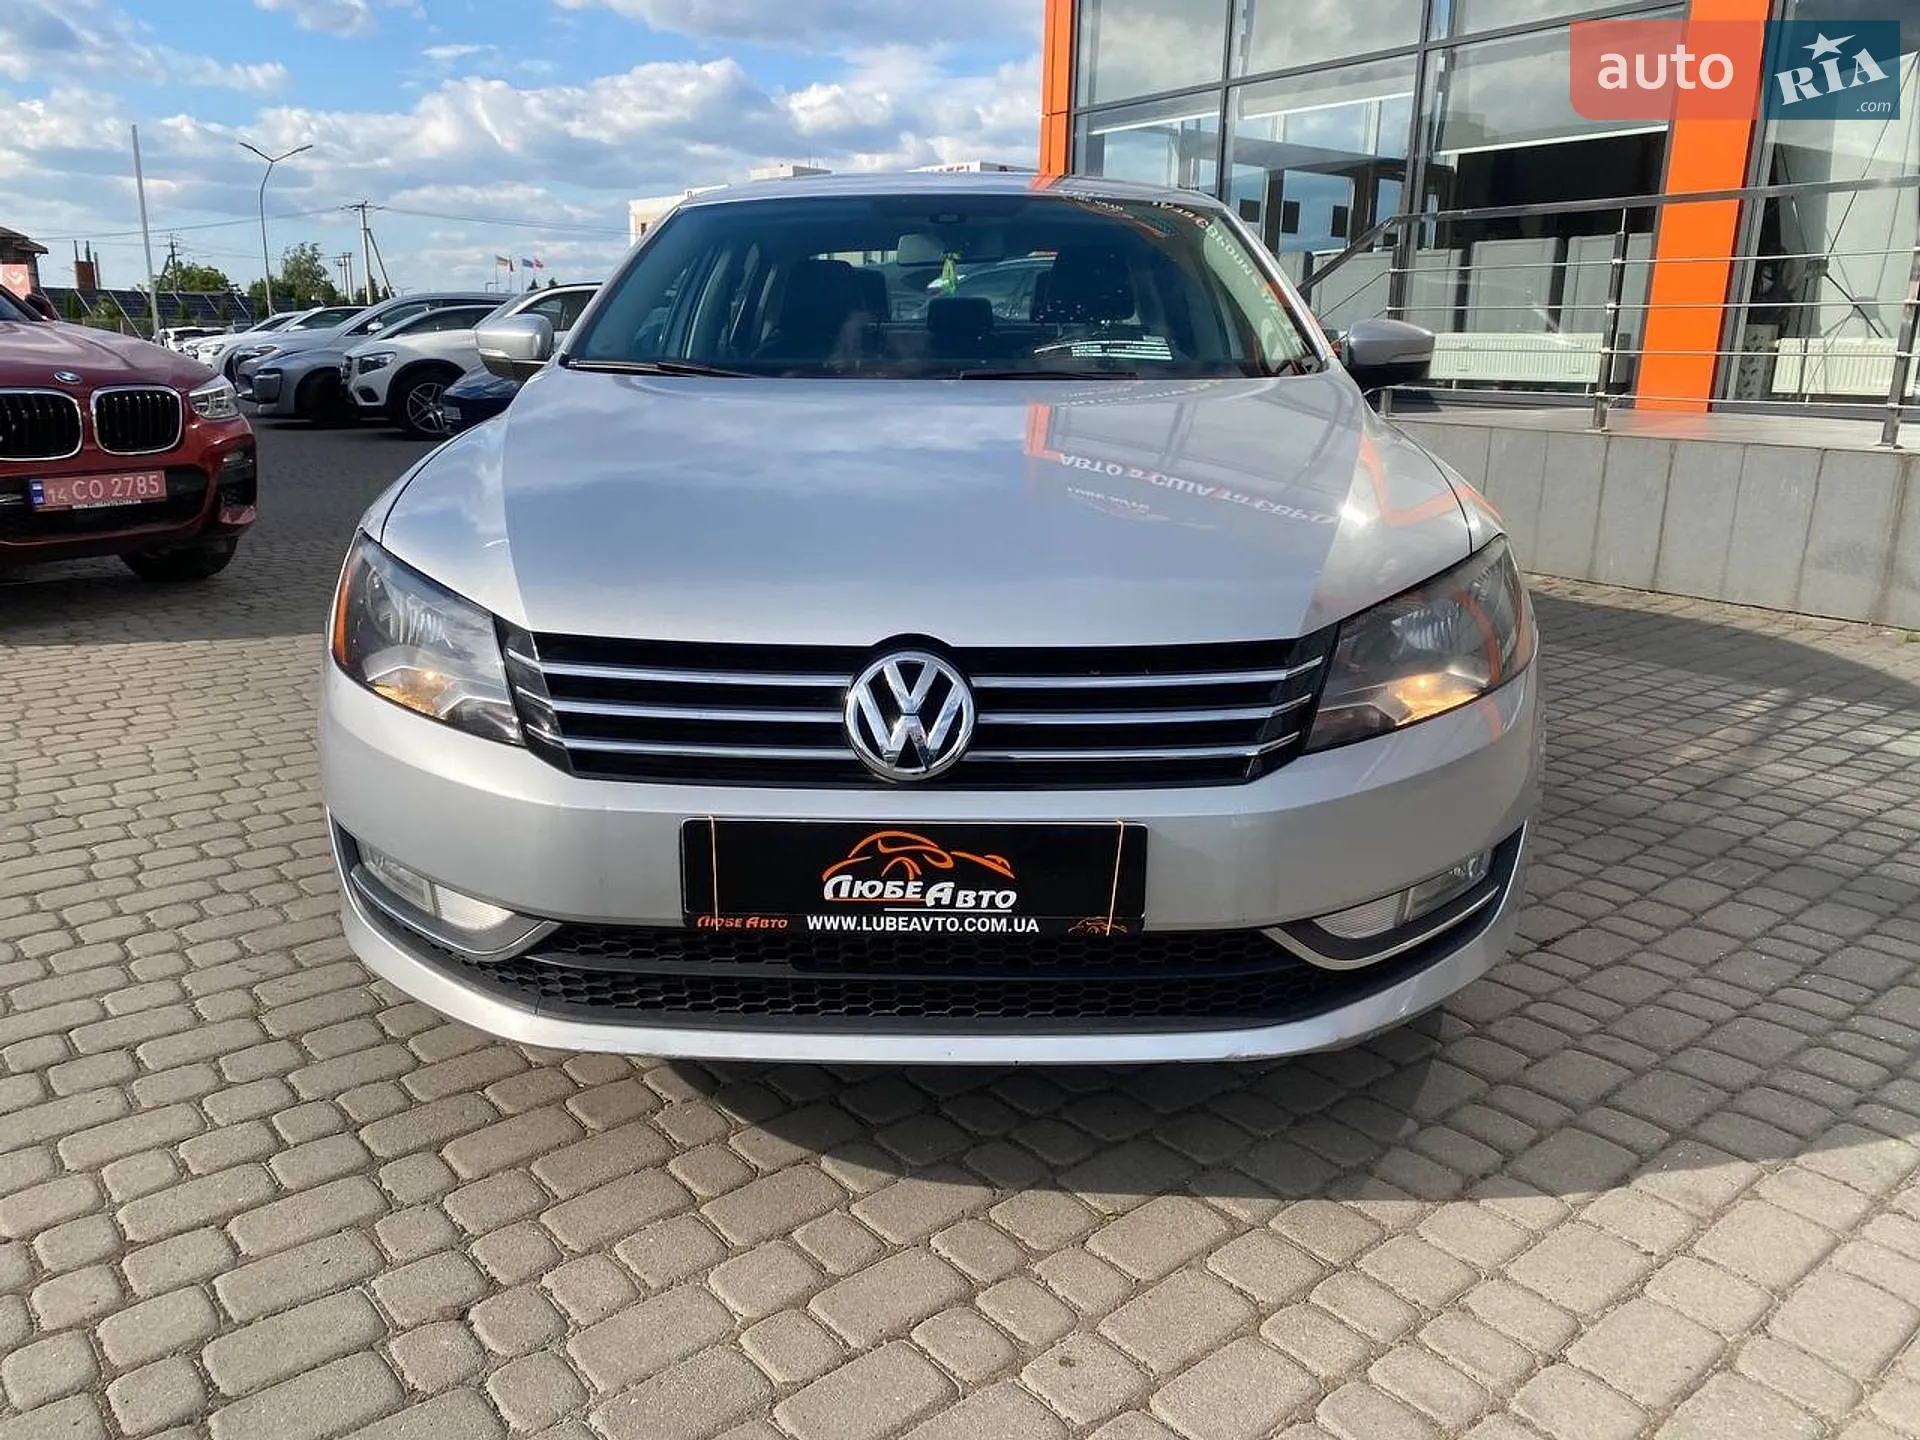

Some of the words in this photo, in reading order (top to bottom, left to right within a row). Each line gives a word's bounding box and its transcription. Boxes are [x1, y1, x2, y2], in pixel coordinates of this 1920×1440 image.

[71, 479, 104, 500] CO
[111, 474, 159, 498] 2785
[807, 915, 1040, 933] WWW.LUBEAVTO.COM.UA
